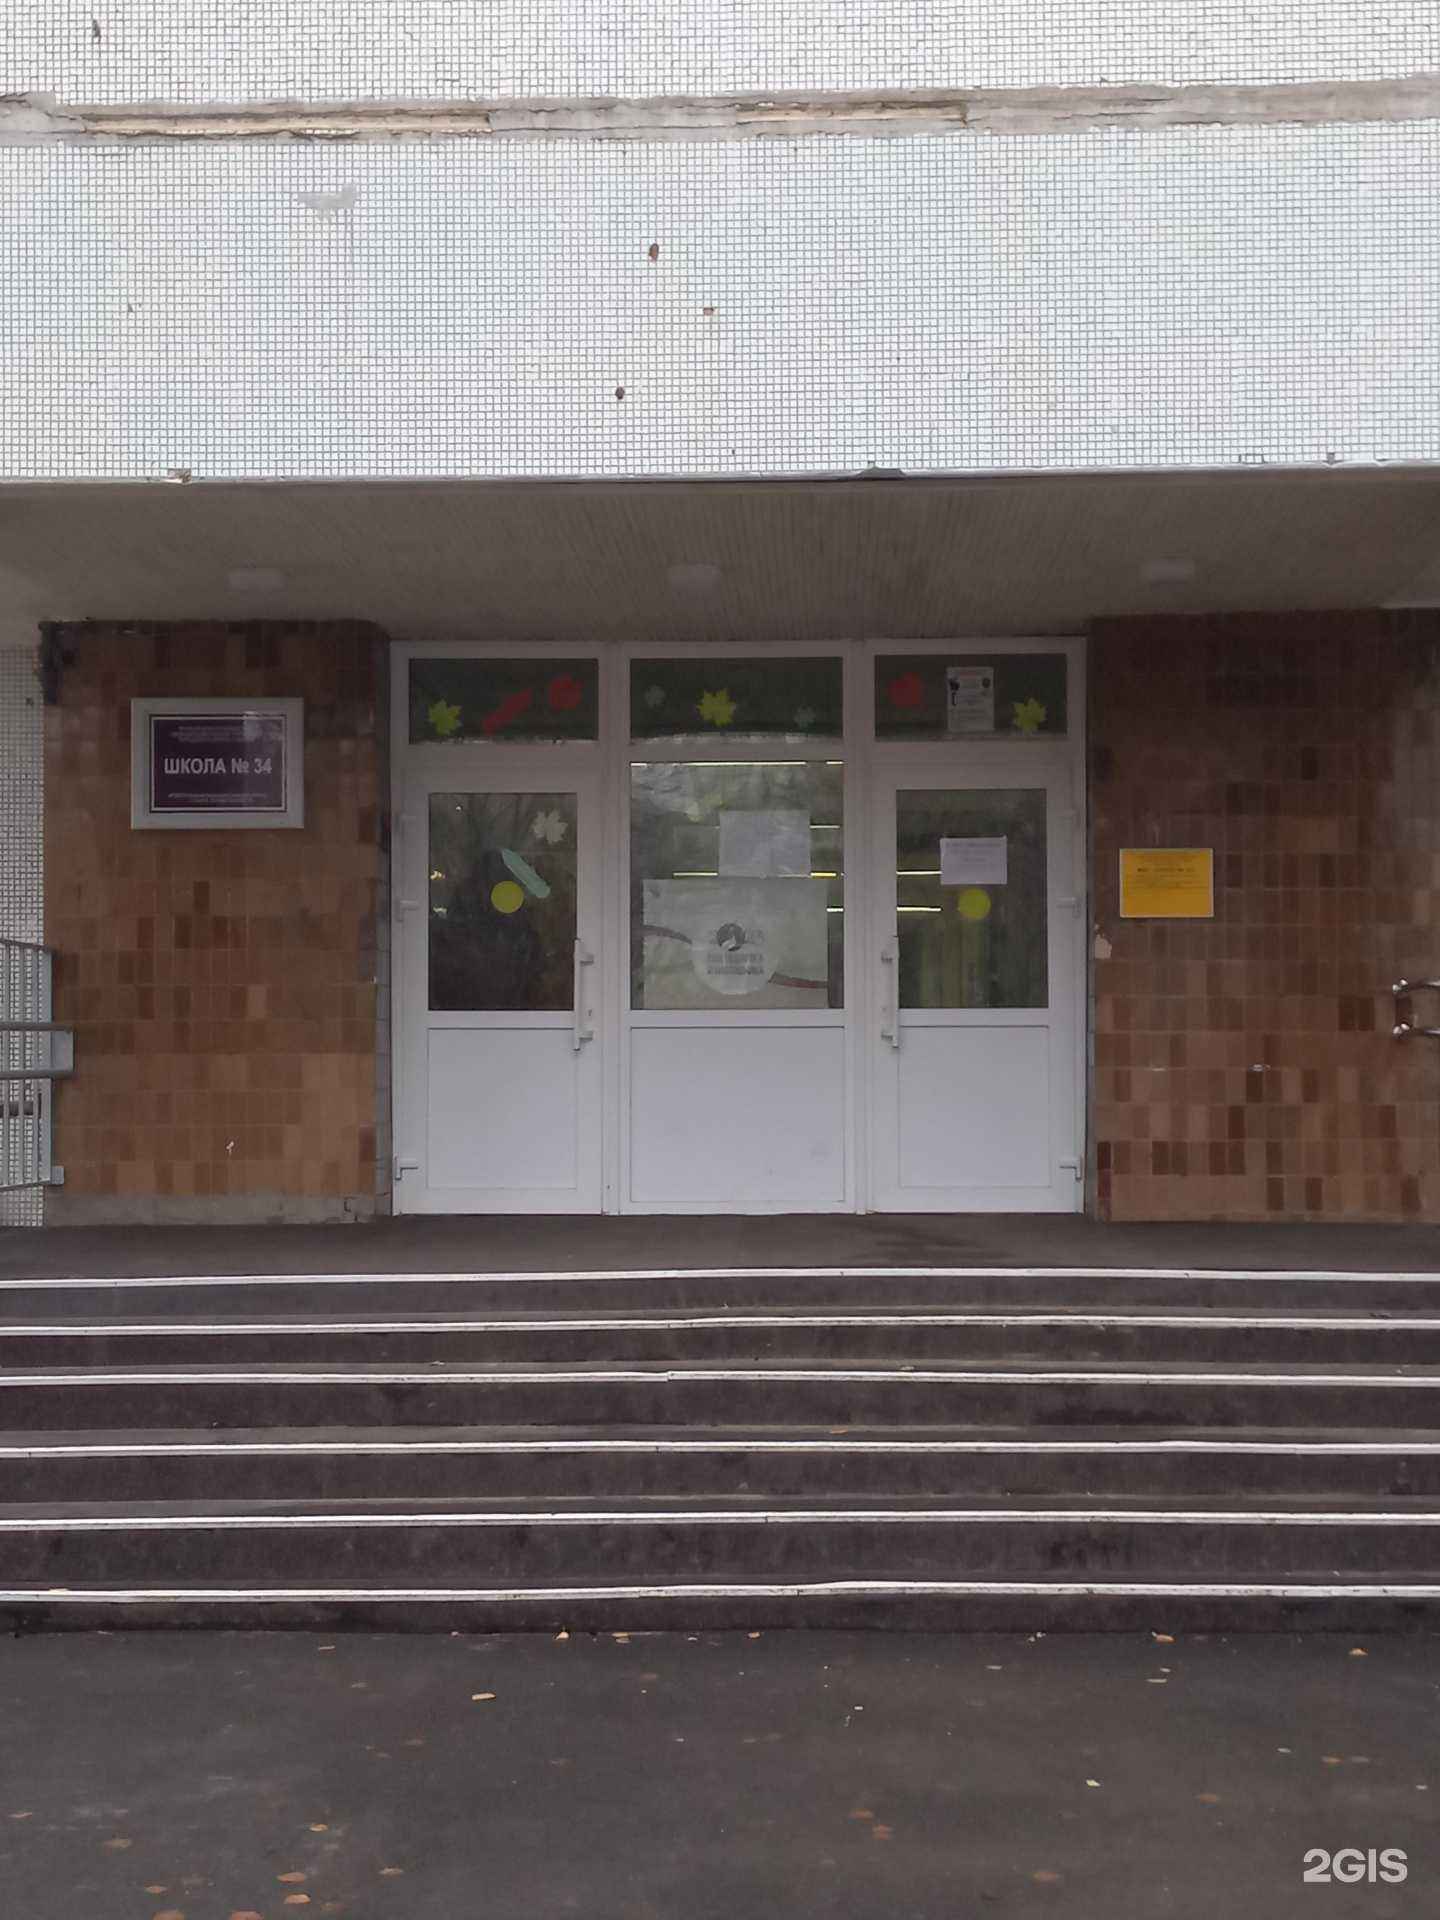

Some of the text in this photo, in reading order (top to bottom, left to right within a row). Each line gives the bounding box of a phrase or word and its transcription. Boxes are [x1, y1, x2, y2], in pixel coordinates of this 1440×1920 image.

[164, 757, 272, 775] ШКОЛА № 34
